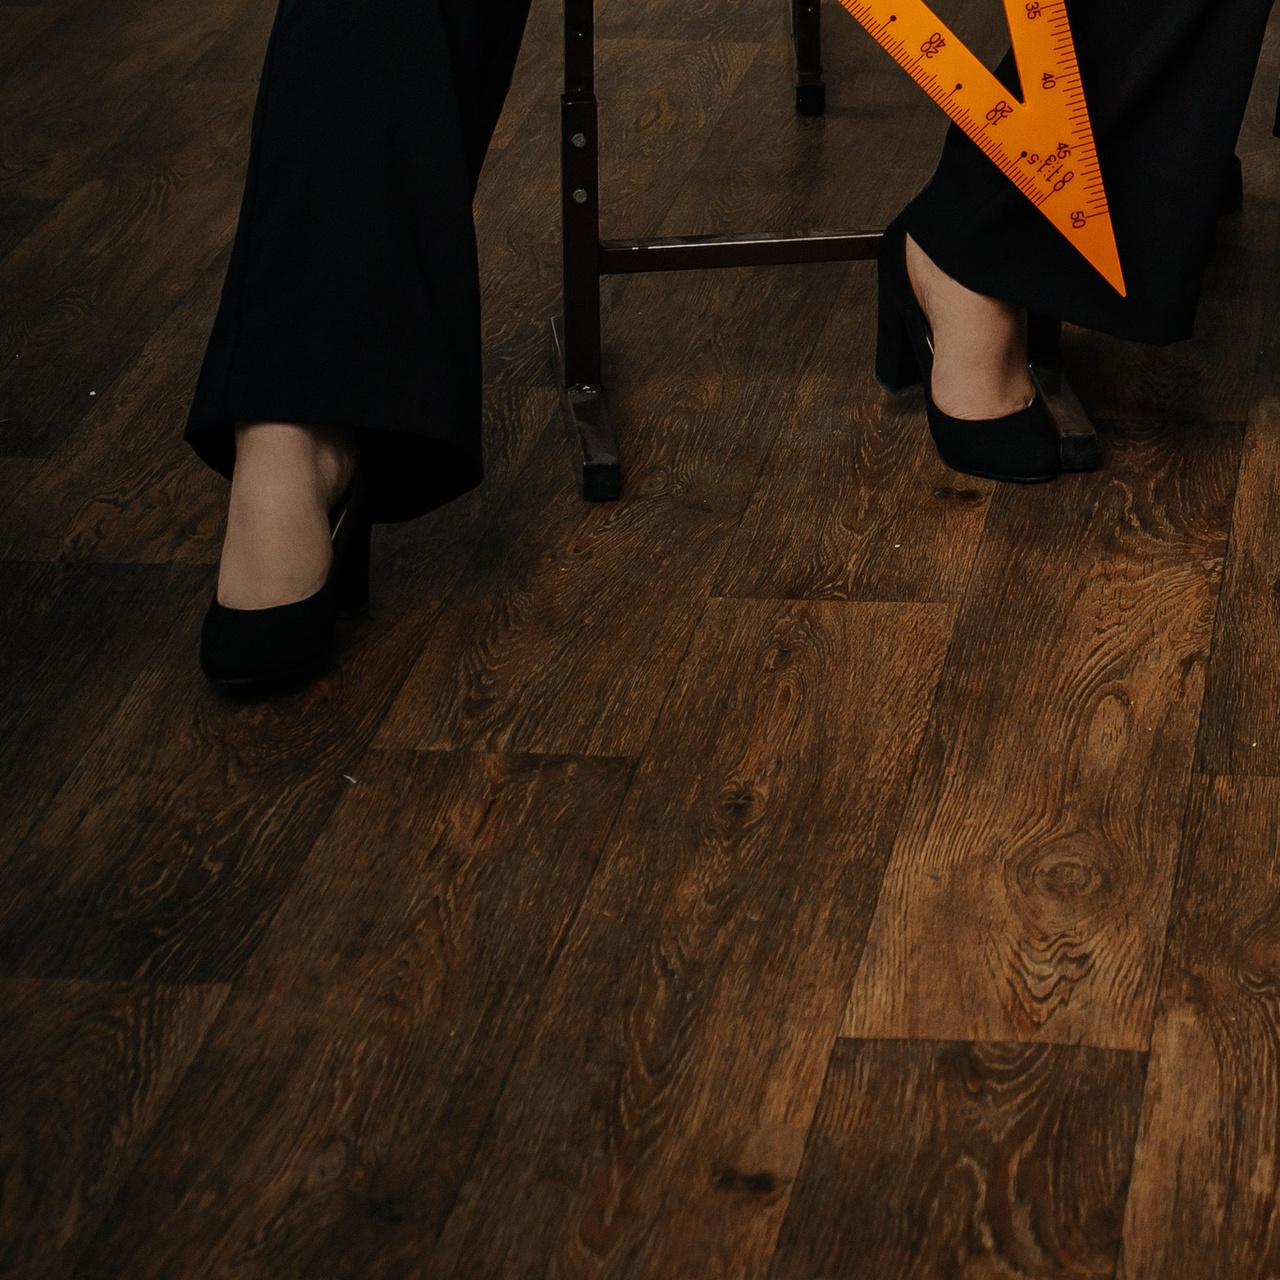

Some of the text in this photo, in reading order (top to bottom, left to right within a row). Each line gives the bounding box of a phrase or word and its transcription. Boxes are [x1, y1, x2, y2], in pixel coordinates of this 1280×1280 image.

[1025, 1, 1042, 20] 35
[920, 39, 939, 59] 20
[929, 32, 947, 49] 40
[1041, 72, 1056, 90] 40
[985, 108, 1003, 127] 10
[994, 100, 1014, 118] 20
[1056, 142, 1072, 160] 45
[1070, 210, 1086, 229] 50
